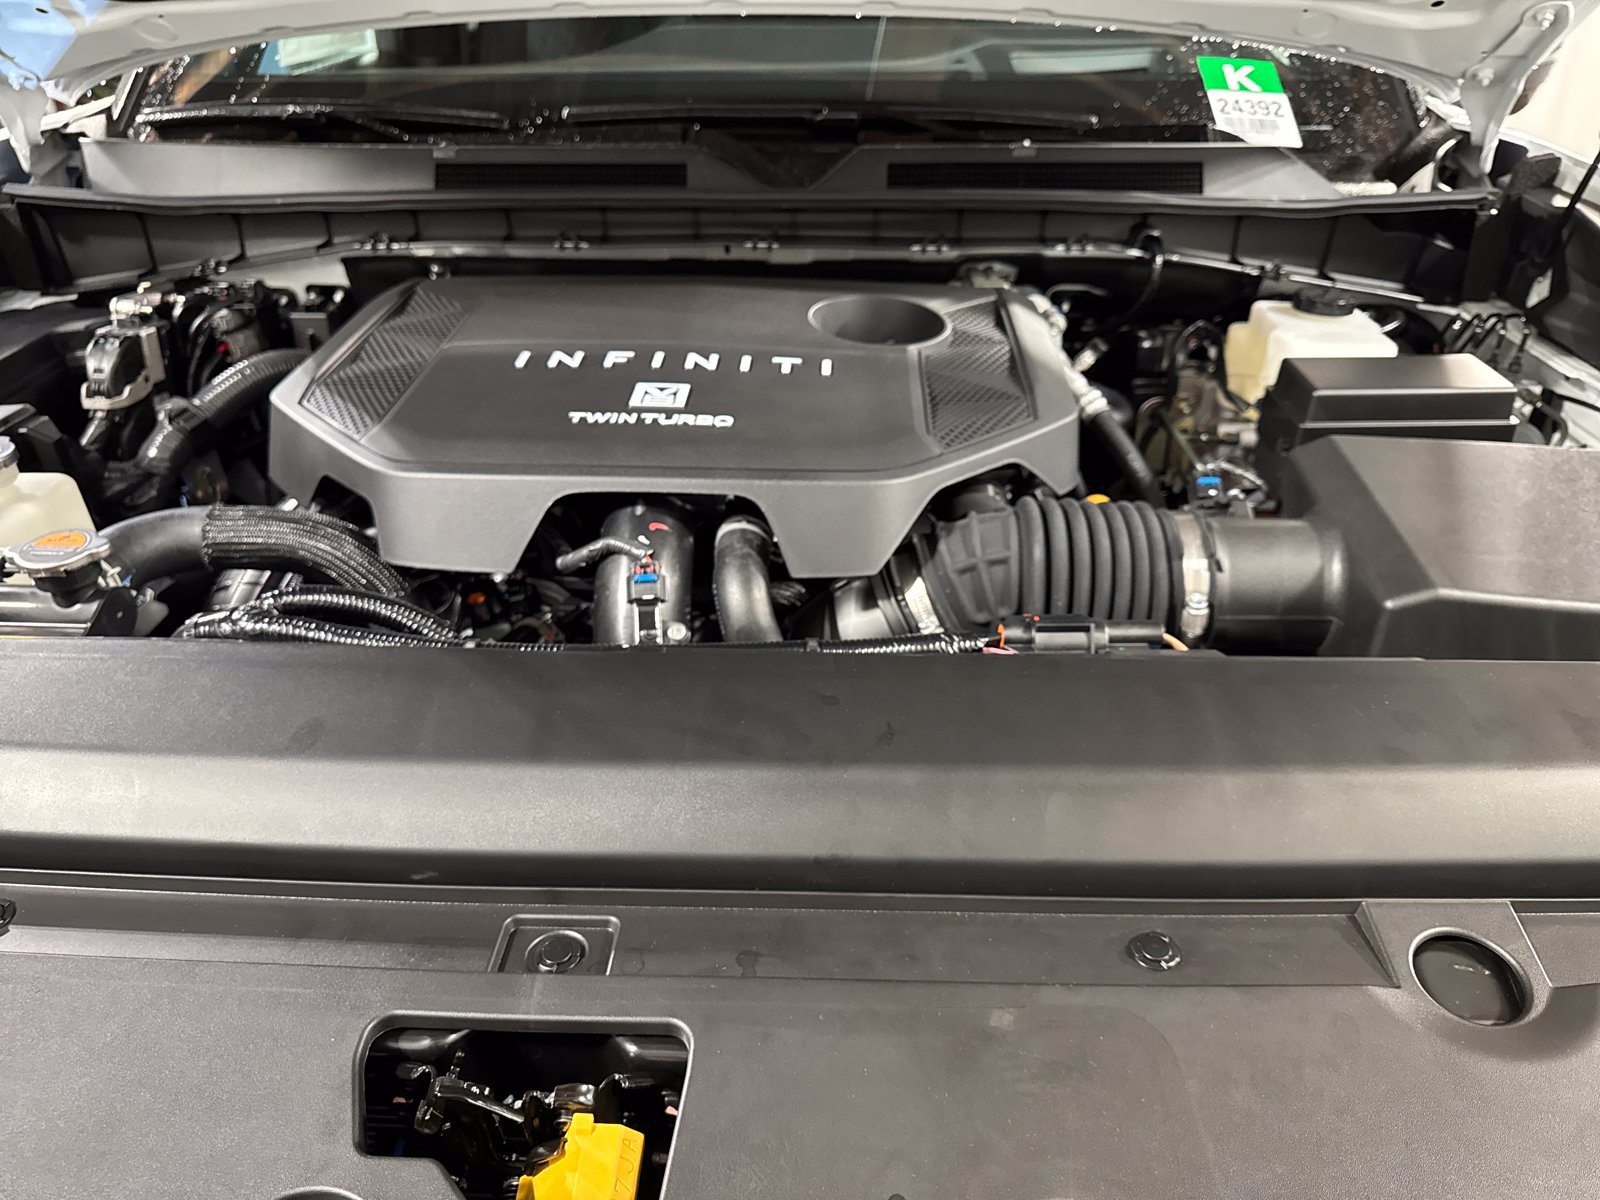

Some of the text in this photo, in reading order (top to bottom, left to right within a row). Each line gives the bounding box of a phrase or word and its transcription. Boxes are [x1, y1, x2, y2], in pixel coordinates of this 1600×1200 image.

[1221, 63, 1263, 92] K
[1216, 98, 1285, 118] 24392
[514, 350, 832, 376] INFINITI
